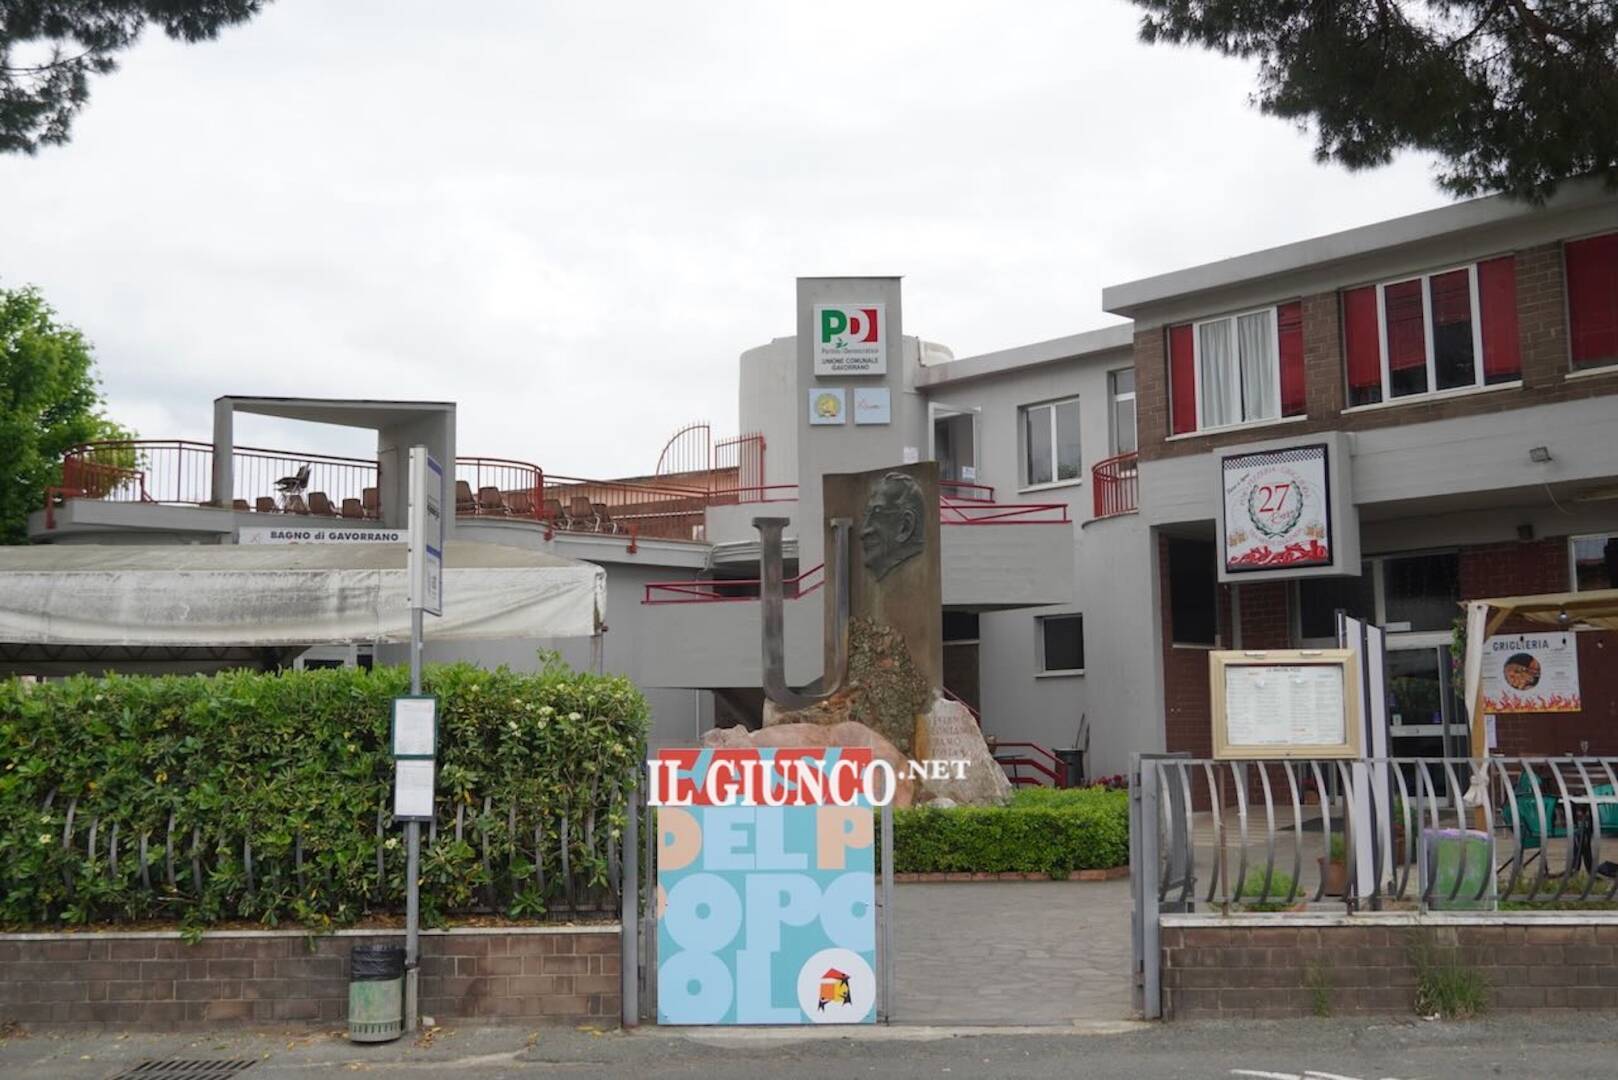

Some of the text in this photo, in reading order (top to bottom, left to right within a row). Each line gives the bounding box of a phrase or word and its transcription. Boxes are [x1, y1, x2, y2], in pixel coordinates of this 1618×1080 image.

[821, 308, 878, 343] PD
[1257, 483, 1291, 513] 27
[270, 530, 399, 541] BAGNO di GAVORRANO
